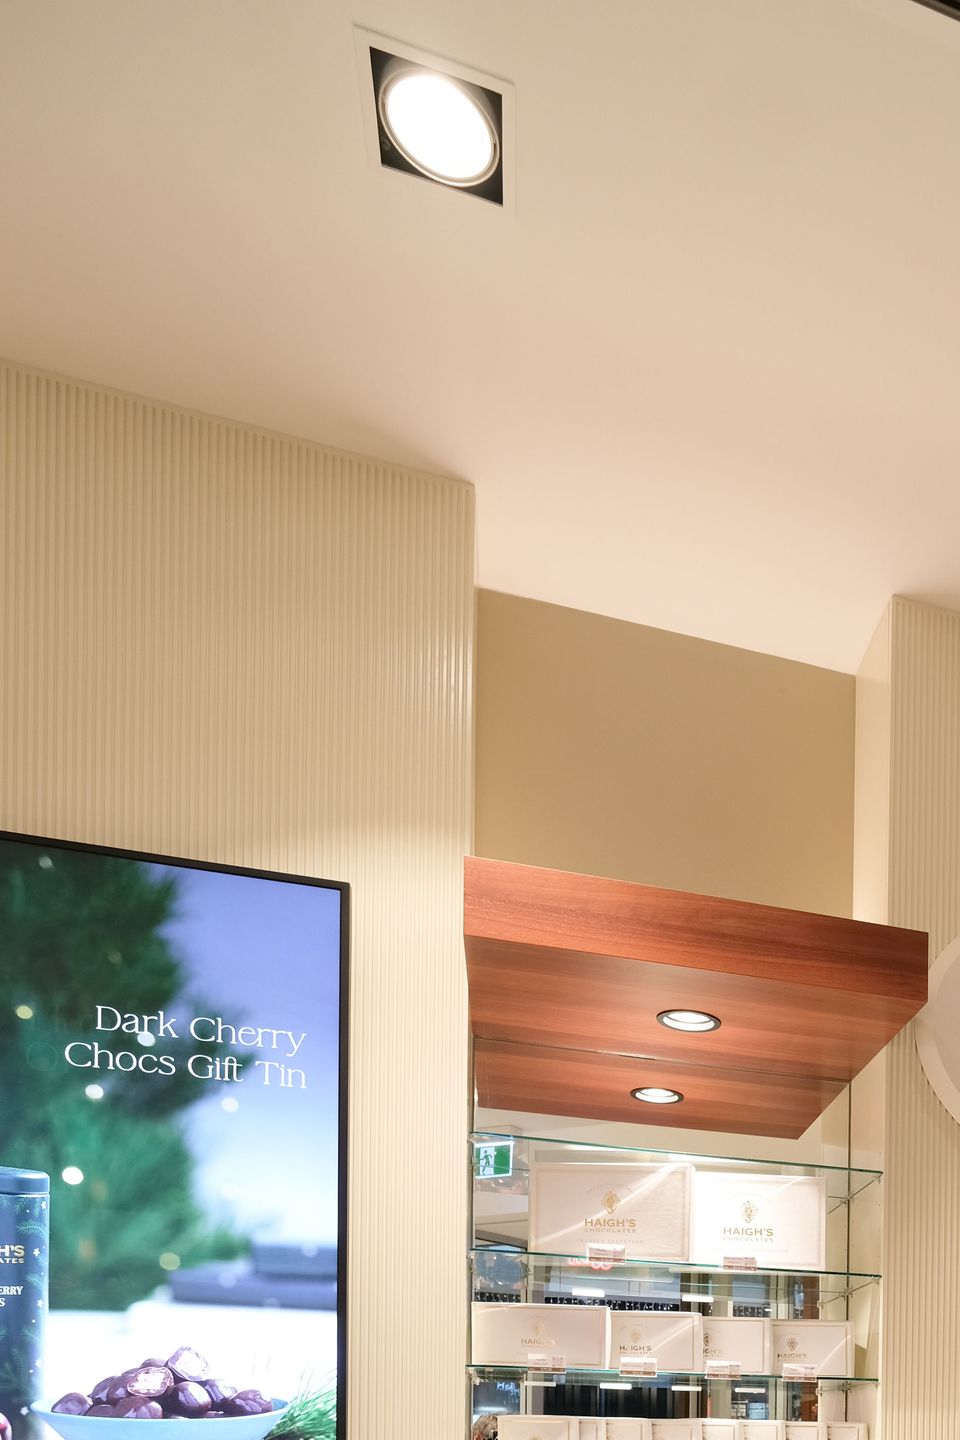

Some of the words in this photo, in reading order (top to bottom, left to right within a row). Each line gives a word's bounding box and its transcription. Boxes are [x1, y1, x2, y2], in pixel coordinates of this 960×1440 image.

[95, 1005, 179, 1038] Dark
[189, 1016, 307, 1057] Cherry
[64, 1041, 177, 1076] Chocs
[187, 1054, 245, 1083] Gift
[255, 1060, 307, 1089] Tin
[584, 1218, 637, 1228] HAIGH'S
[723, 1226, 774, 1237] HAIGH'S
